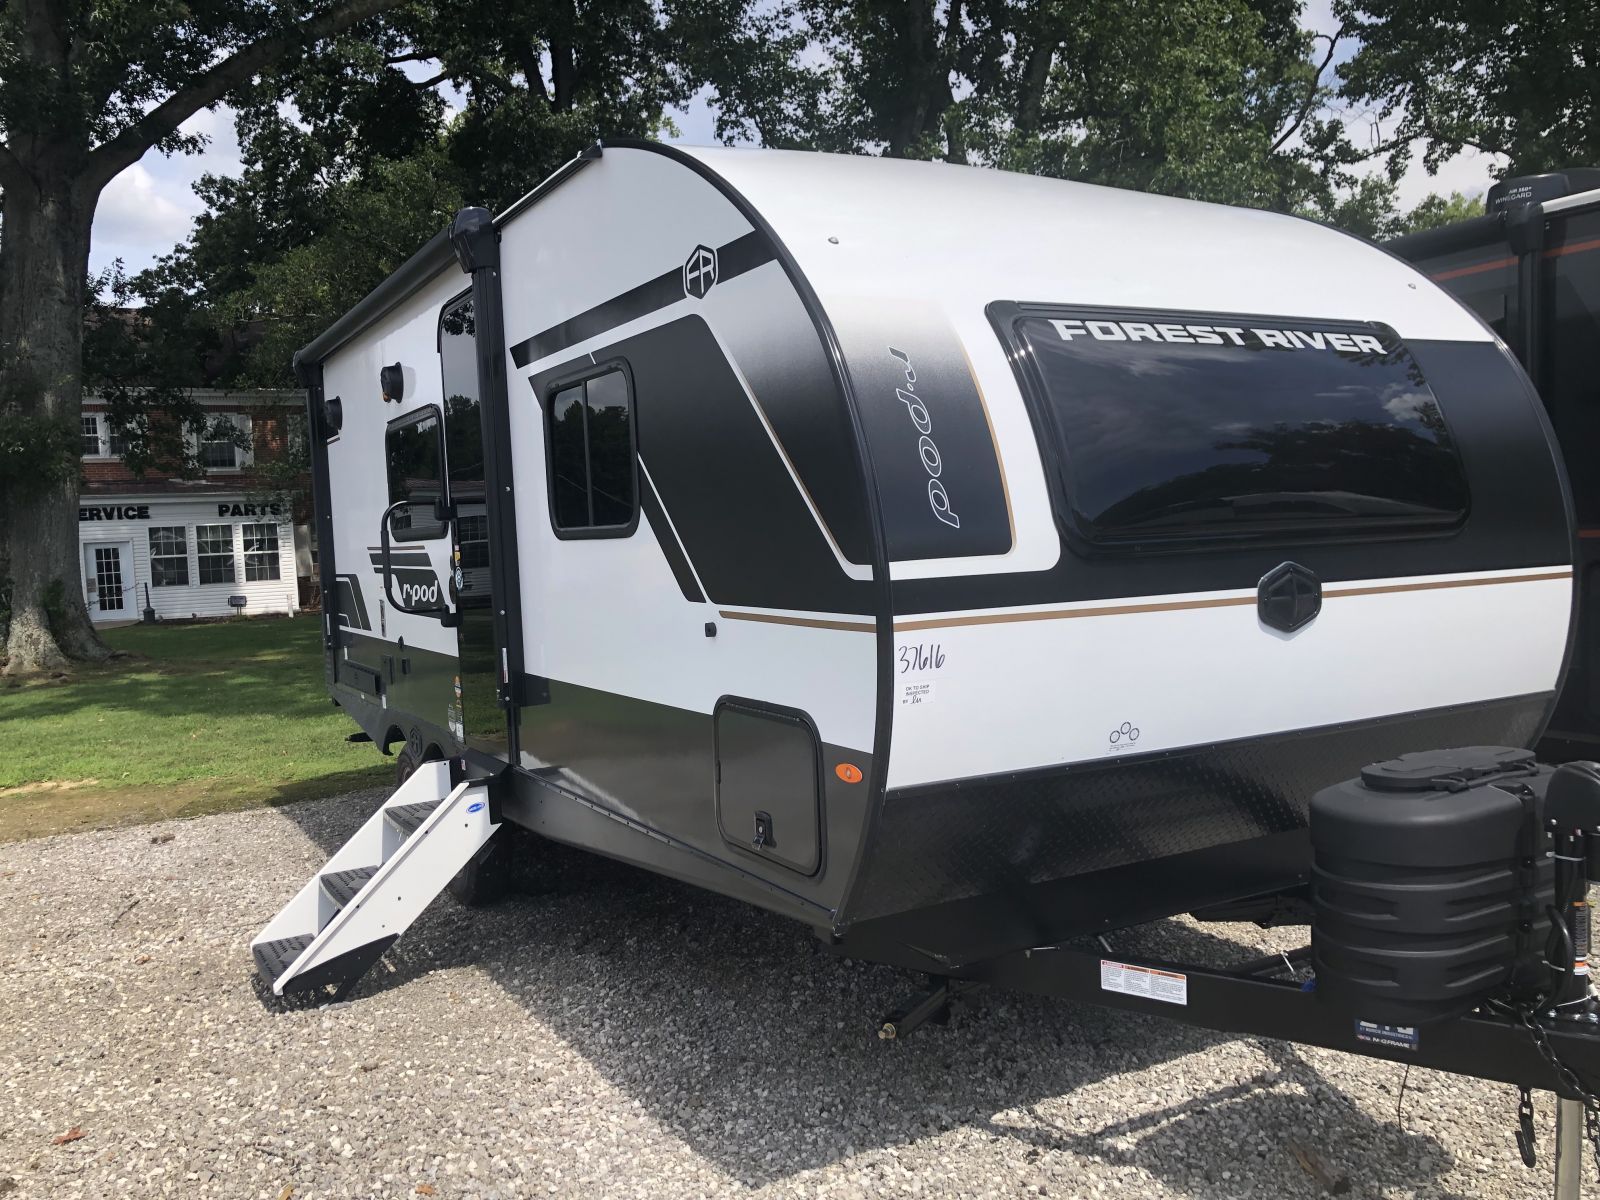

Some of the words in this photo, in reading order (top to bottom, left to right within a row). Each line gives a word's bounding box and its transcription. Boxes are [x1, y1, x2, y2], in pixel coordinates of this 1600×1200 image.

[1047, 319, 1246, 346] FOREST
[1250, 328, 1388, 355] RIVER
[79, 505, 150, 521] ERVICE
[218, 503, 282, 517] PARTS
[899, 644, 946, 674] 37616
